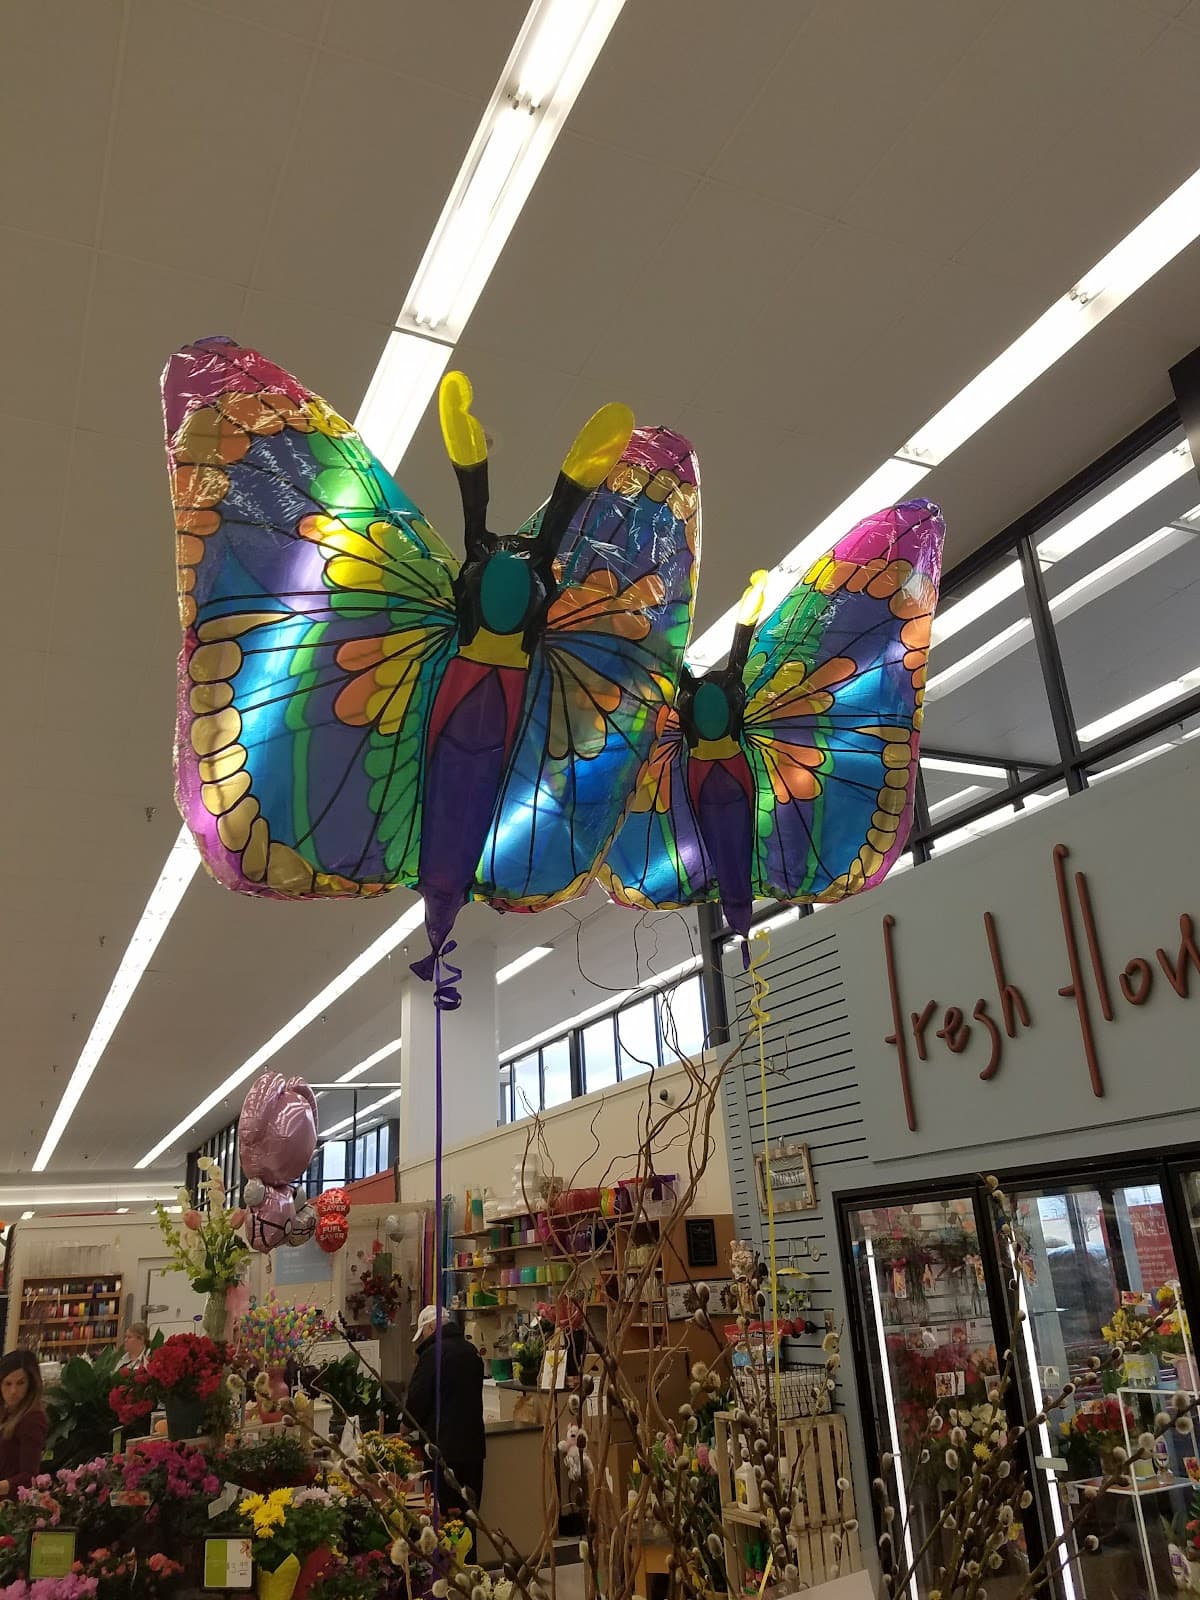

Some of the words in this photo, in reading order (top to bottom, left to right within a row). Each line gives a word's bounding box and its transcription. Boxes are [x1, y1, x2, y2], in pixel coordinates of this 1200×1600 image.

[882, 911, 1031, 1132] fresh
[322, 1225, 342, 1233] FUEL
[319, 1232, 345, 1240] SAVER
